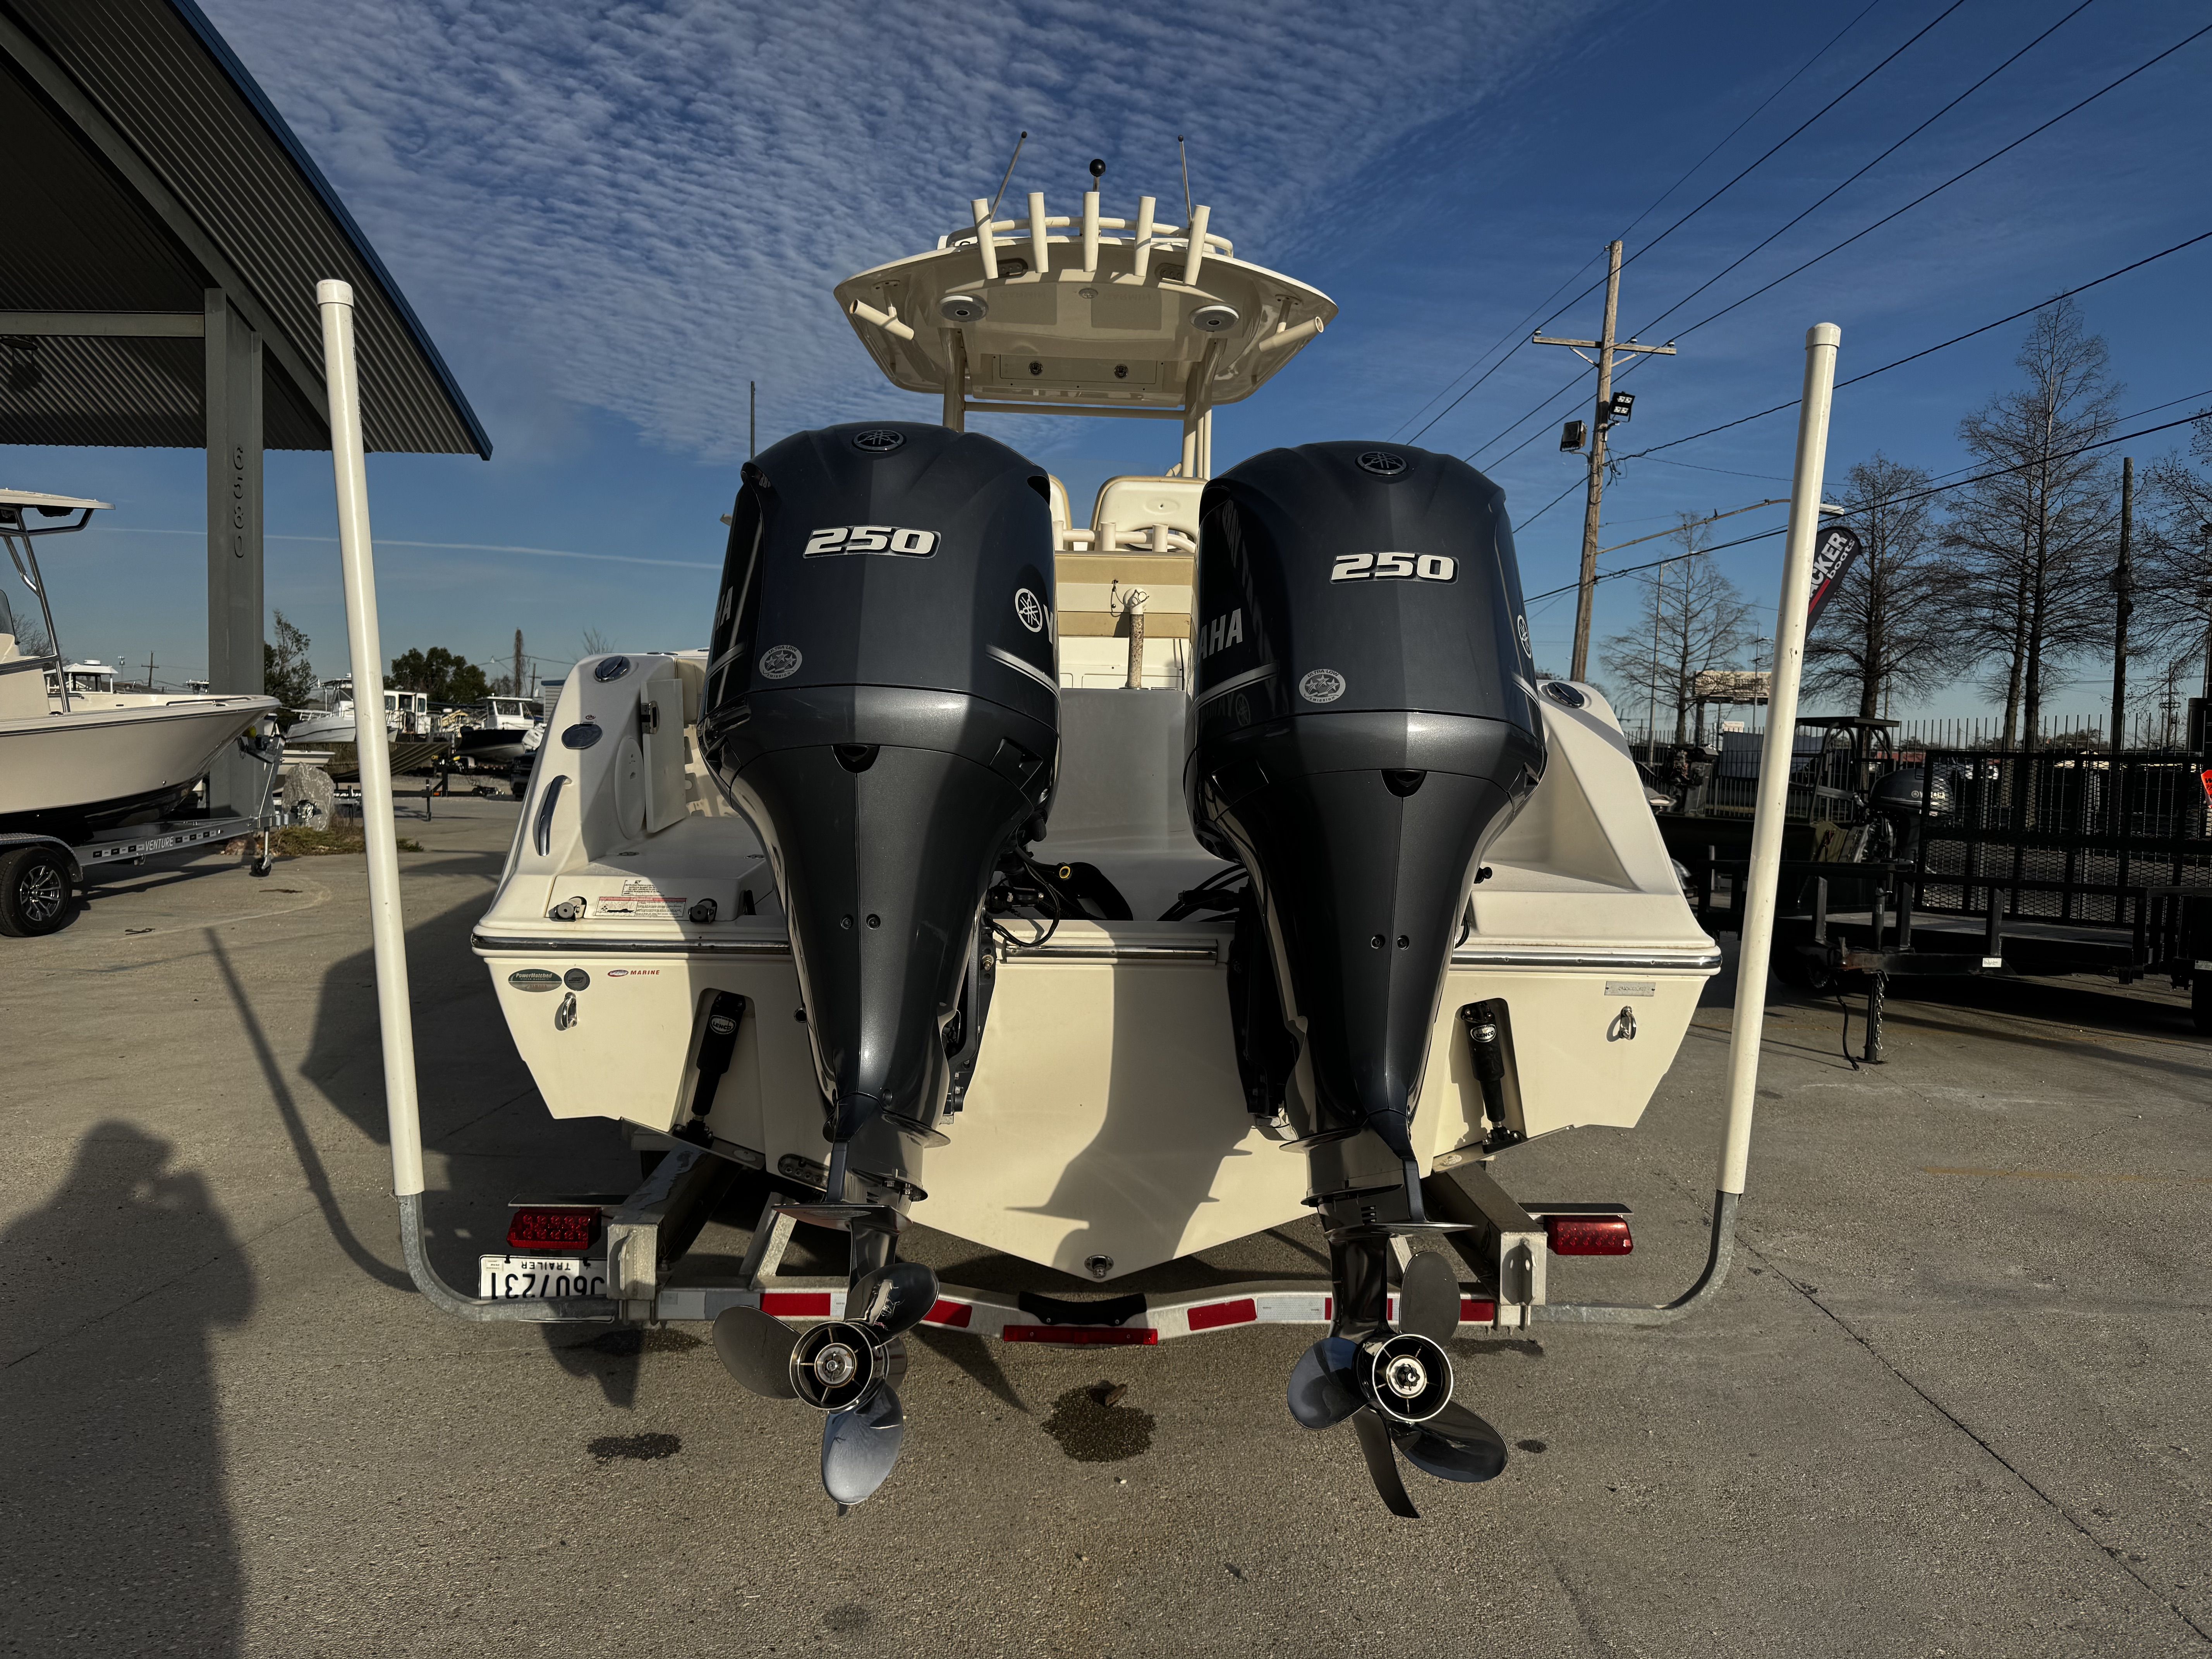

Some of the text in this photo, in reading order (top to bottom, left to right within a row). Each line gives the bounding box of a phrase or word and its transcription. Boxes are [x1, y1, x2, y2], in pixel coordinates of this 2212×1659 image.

[804, 526, 936, 555] 250
[1331, 552, 1455, 581] 250
[1826, 539, 1855, 579] boats
[145, 836, 174, 851] VENTURE
[713, 1021, 732, 1030] LENCO
[521, 1261, 571, 1271] TRAILER
